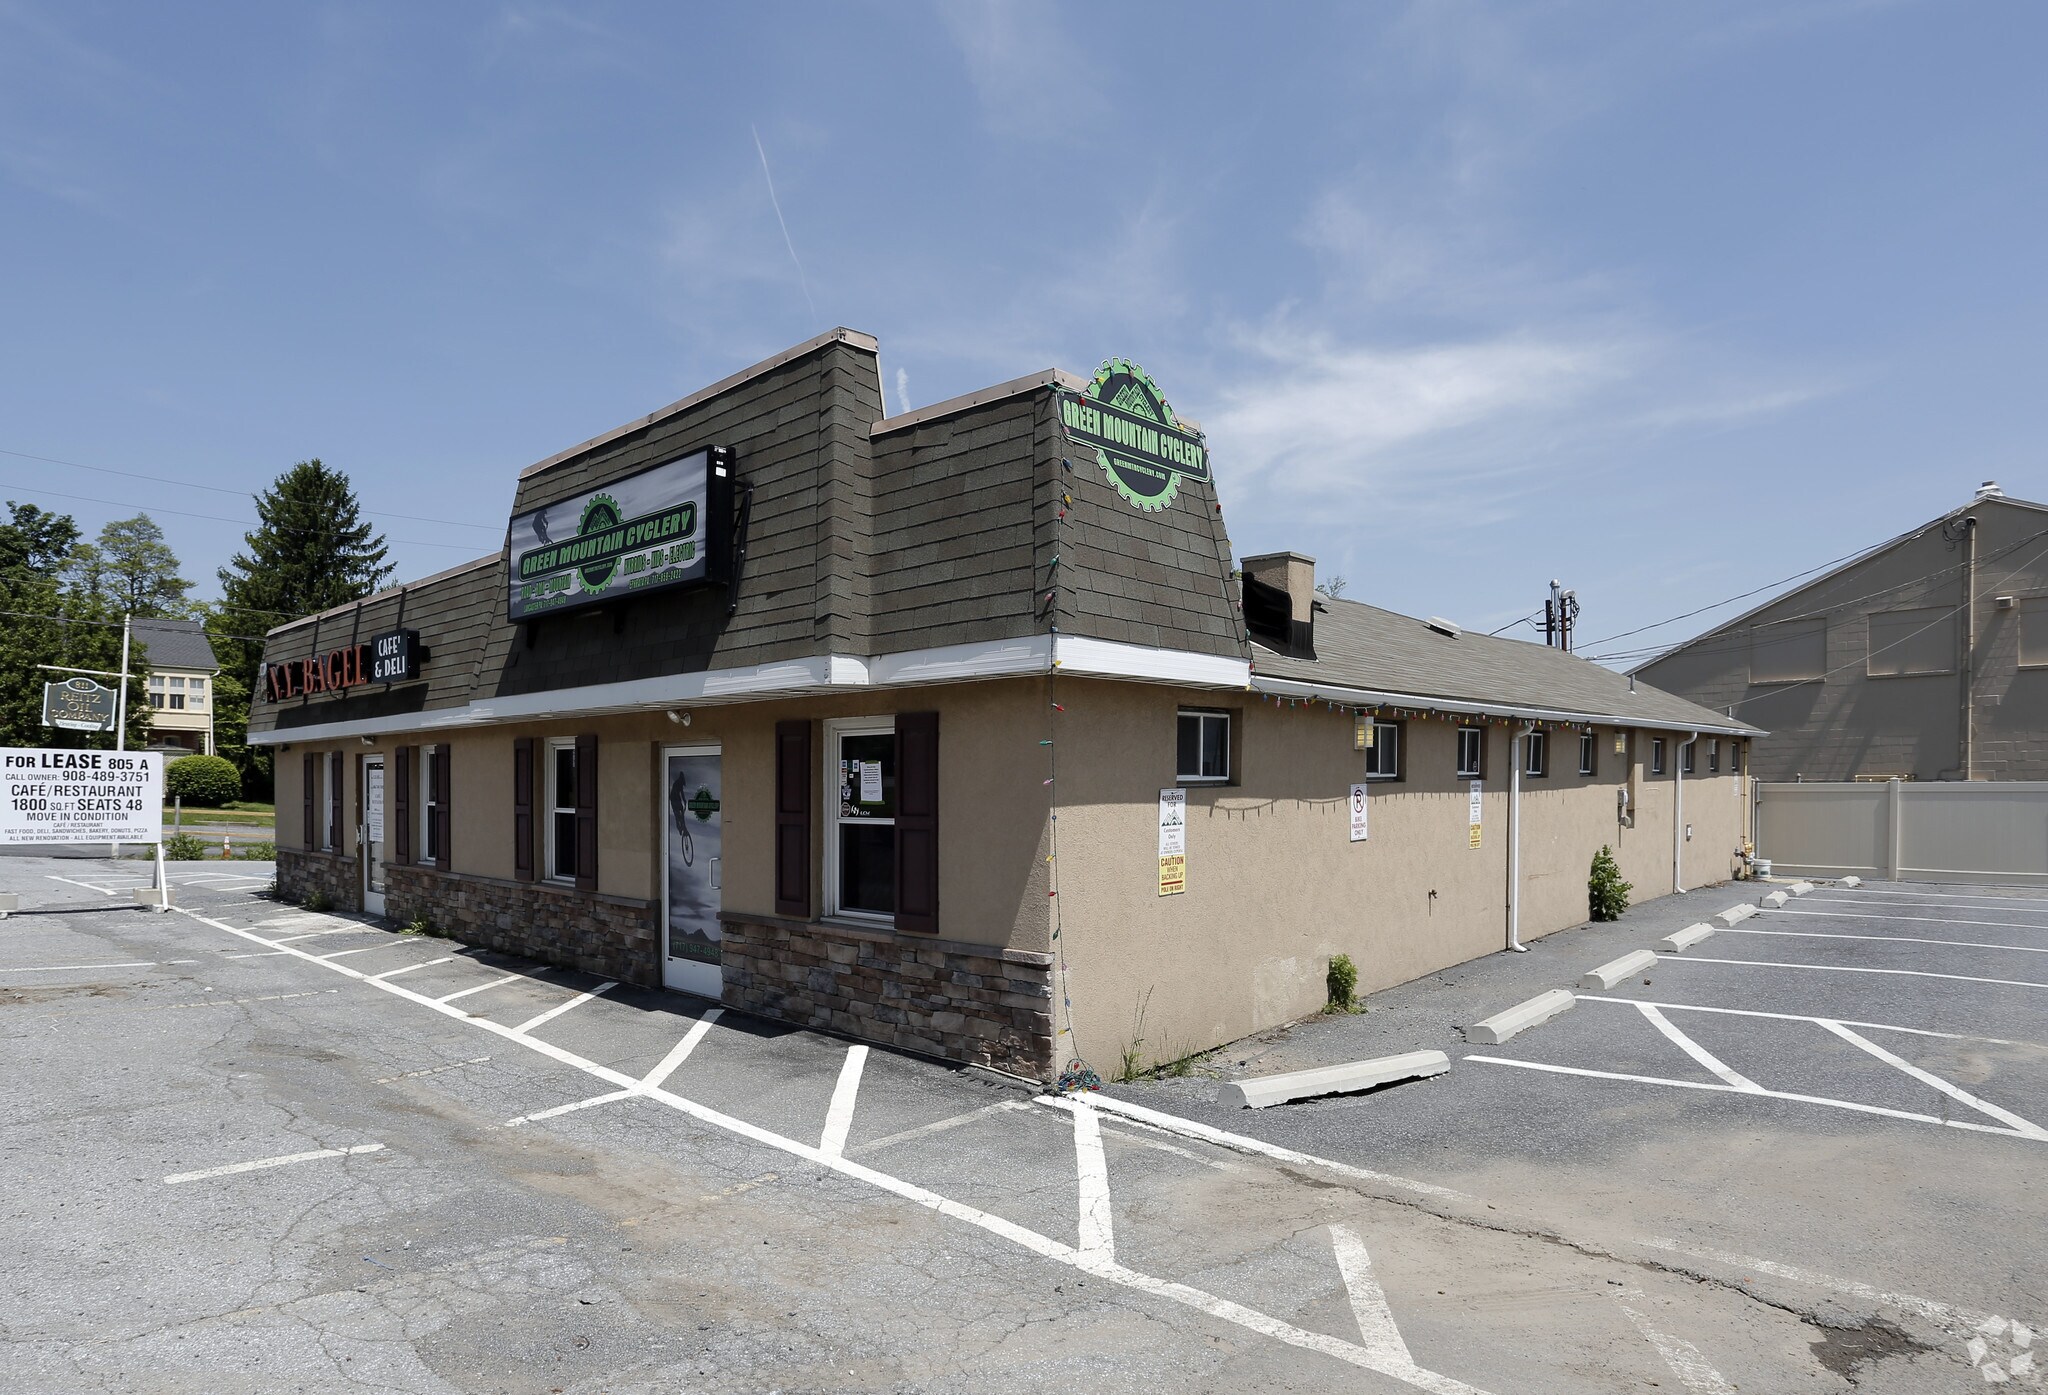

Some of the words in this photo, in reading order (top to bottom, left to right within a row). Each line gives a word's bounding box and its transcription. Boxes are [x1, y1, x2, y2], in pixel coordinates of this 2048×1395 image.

[1063, 400, 1101, 436] GREEN
[1103, 412, 1158, 455] MOUNTAIN
[1160, 434, 1202, 470] CYCLERY
[522, 552, 557, 575] GREEN
[558, 532, 622, 565] MOUNTAIN
[625, 510, 692, 545] CYCLERY
[669, 541, 696, 564] ELECTRIC
[303, 645, 366, 694] BAGEL
[375, 661, 382, 678] &
[384, 655, 406, 677] DELI
[60, 690, 101, 703] REITZ
[67, 701, 93, 712] OIL
[50, 709, 109, 721] COMPANY
[5, 756, 36, 768] FOR
[41, 753, 102, 769] LEASE
[108, 758, 134, 770] 805
[139, 759, 149, 770] A
[5, 773, 26, 781] CALL
[27, 773, 60, 781] OWNER:
[62, 770, 150, 782] 908-489-3751
[11, 782, 143, 797] CAFÉ/RESTAURANT
[11, 798, 47, 811] 1800
[77, 798, 122, 811] SEATS
[125, 799, 143, 811] 48
[26, 812, 57, 821] MOVE
[60, 812, 71, 821] IN
[73, 812, 129, 821] CONDITION
[1161, 856, 1184, 867] CAUTION
[1161, 873, 1177, 881] BACKING
[1178, 871, 1184, 879] UP
